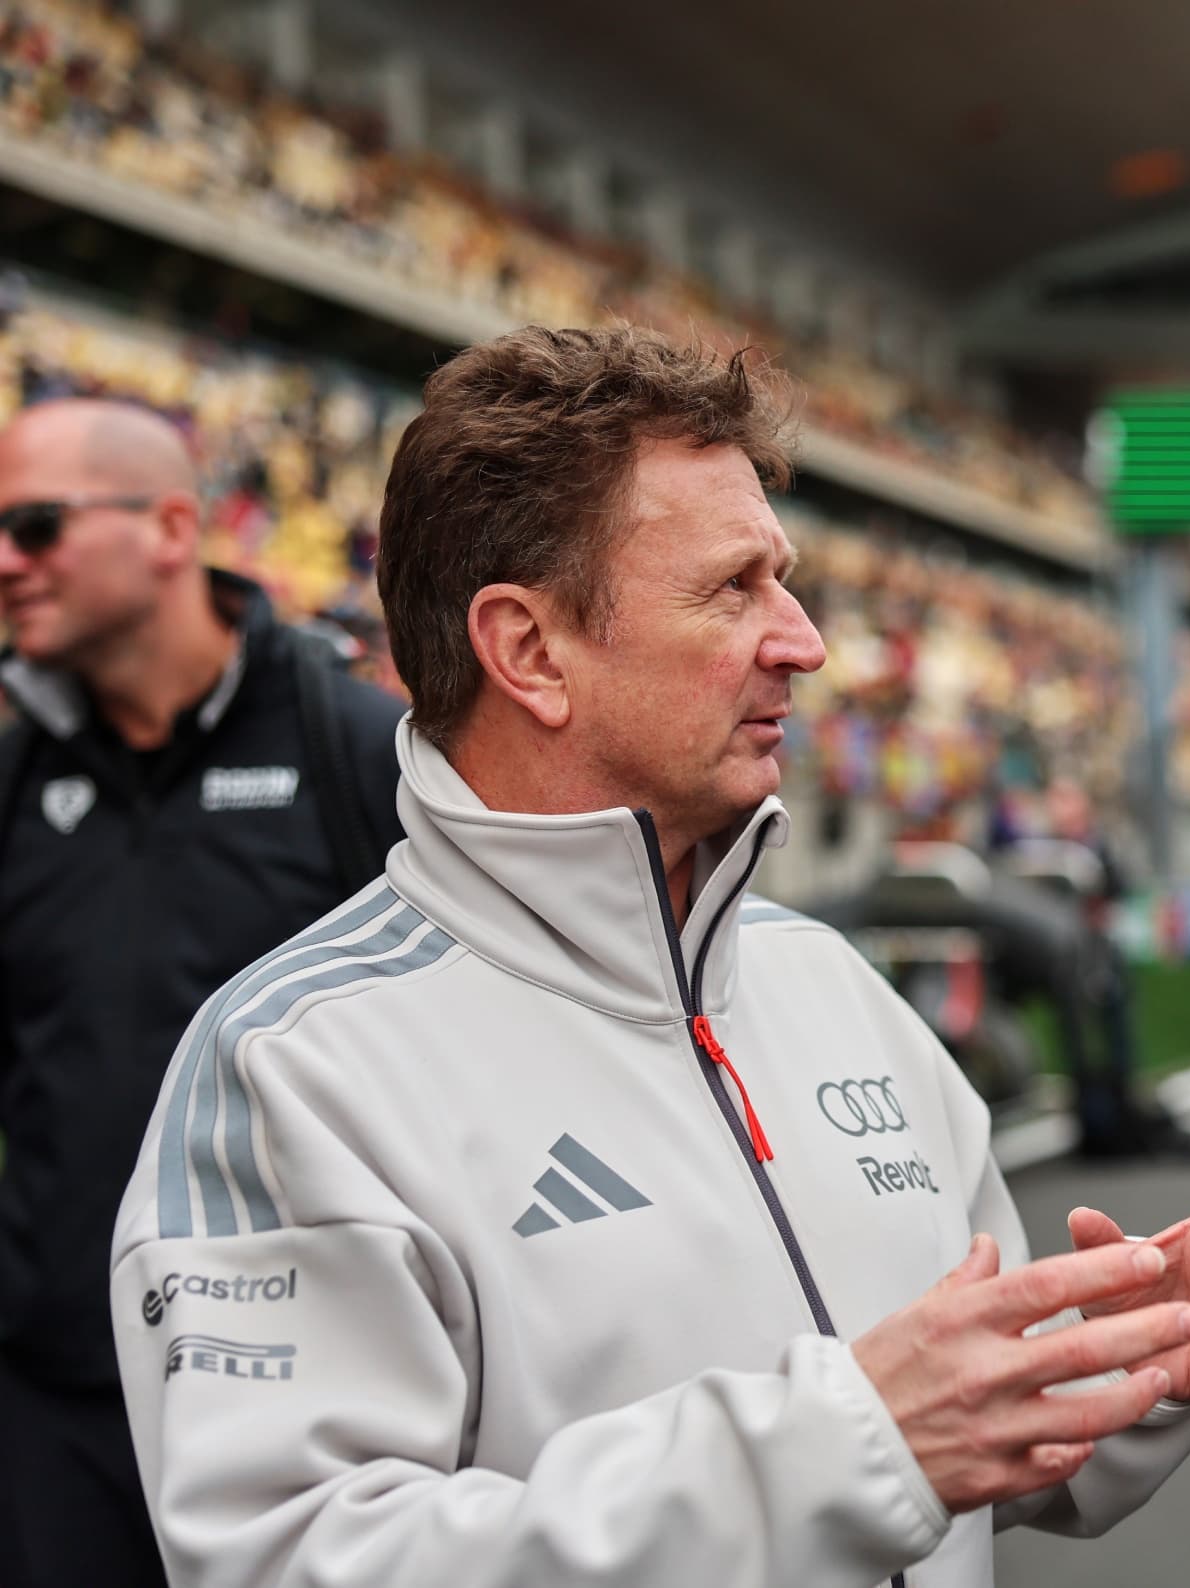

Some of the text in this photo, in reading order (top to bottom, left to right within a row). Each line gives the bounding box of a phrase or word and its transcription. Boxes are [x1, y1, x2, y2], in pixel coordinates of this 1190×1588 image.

[855, 1149, 940, 1196] Revolt
[162, 1267, 296, 1304] Castrol
[164, 1334, 297, 1384] RELLI
